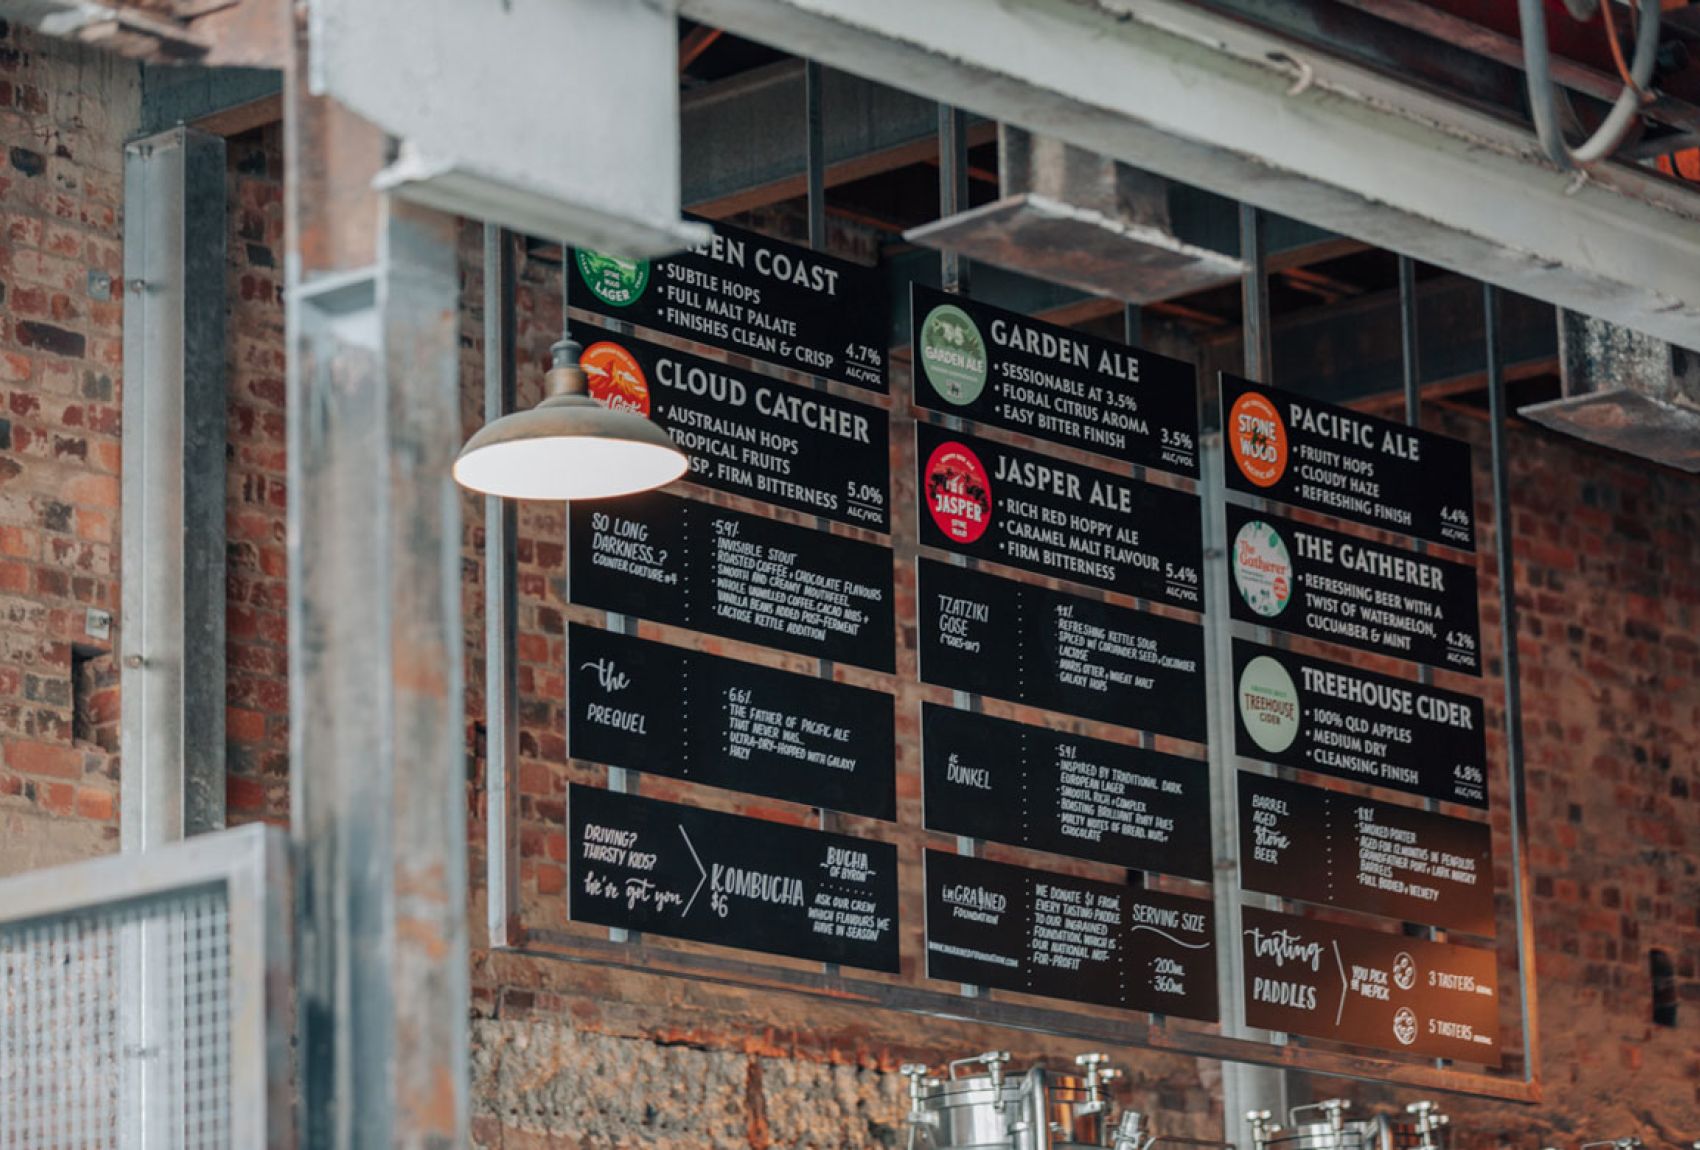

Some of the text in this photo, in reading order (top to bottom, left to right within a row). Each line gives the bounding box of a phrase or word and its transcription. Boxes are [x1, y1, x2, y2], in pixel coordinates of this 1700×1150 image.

[667, 263, 717, 292] SUBTLE
[723, 278, 760, 304] HOPS
[755, 249, 838, 295] COAST
[595, 282, 630, 301] LAGER
[668, 286, 796, 337] FULL MALT PALATE
[667, 308, 833, 369] FINISHES CLEAN & CRISP
[992, 320, 1139, 382] GARDEN ALE
[846, 343, 881, 366] 4.7%
[925, 346, 966, 369] GARDEN
[966, 359, 983, 374] ALE
[846, 366, 881, 384] ALC/VOL
[1002, 362, 1084, 397] SESSIONABLE
[1088, 387, 1102, 402] AT
[1107, 391, 1136, 411] 3.5%
[656, 359, 746, 406] CLOUD
[756, 388, 870, 443] CATCHER
[1003, 384, 1149, 435] FLORAL CITRUS AROMA
[668, 405, 798, 455] AUSTRALIAN HOPS
[1004, 404, 1125, 449] EASY BITTER FINISH
[1161, 428, 1193, 449] 3.5%
[1238, 414, 1276, 441] STONE
[1290, 404, 1374, 448] PACIFIC
[1382, 431, 1419, 461] ALE
[667, 426, 790, 474] TROPICAL FRUITS
[1162, 452, 1194, 467] ALC/VOL
[1301, 445, 1374, 477] FRUITY HOPS
[688, 455, 837, 510] ISP, FIRM BITTERNESS
[848, 481, 883, 504] 5.0%
[995, 456, 1081, 501] JASPER
[1089, 482, 1131, 513] ALE
[1302, 465, 1347, 488] CLOUDY
[1350, 478, 1379, 498] HAZE
[847, 506, 883, 523] ALC/VOL
[936, 494, 982, 522] JASPER
[1303, 485, 1411, 526] REFRESHING FINISH
[1440, 506, 1469, 525] 4.4%
[592, 513, 648, 542] SO LONG
[1007, 499, 1138, 545] RICH RED HOPPY ALE
[1441, 527, 1469, 542] ALC/VOL
[717, 537, 797, 565] INVISIBLE STOUT
[1007, 520, 1160, 571] CARAMEL MALT FLAVOUR
[1240, 540, 1255, 555] The
[593, 554, 665, 582] COUNTER CULTURE
[717, 550, 841, 591] ROASTED COFFEE CHOCOLATE
[1008, 541, 1115, 581] FIRM BITTERNESS
[1166, 563, 1197, 584] 5.4%
[1239, 552, 1287, 576] Gatherer
[1294, 532, 1444, 591] THE GATHERER
[769, 576, 801, 594] CREAMY
[1166, 586, 1197, 601] ALC/VOL
[1306, 573, 1373, 602] REFRESHING
[1375, 590, 1401, 609] BEER
[1404, 597, 1432, 616] WITH
[1434, 605, 1443, 619] A
[939, 594, 988, 622] TZATZIKI
[1306, 593, 1437, 638] TWIST OF WATERMELON,
[717, 605, 826, 641] LACTOSE KETTLE ADDITION
[939, 614, 968, 637] GOSE
[1058, 618, 1157, 651] REFRESHING KETTLE SOUR
[1307, 613, 1411, 650] CUCUMBER & MINT
[1446, 631, 1474, 649] 4.2%
[1447, 652, 1475, 666] ALC/VOL
[581, 659, 630, 691] the
[1060, 672, 1107, 692] GALAXY HOPS
[1244, 693, 1294, 721] TREEHOUSE
[1302, 667, 1472, 730] TREEHOUSE CIDER
[588, 703, 646, 735] PREQUEL
[729, 703, 850, 742] THE FATHER OF PACIFIC ALE
[730, 717, 779, 739] THAT NEVER
[1259, 713, 1281, 725] CIDER
[1314, 709, 1411, 743] 100% QLD APPLES
[1313, 729, 1387, 757] MEDIUM DRY
[826, 754, 856, 772] GALAXY
[948, 763, 991, 789] DUNKEL
[1060, 760, 1110, 779] INSPIRED BY
[1314, 749, 1418, 784] CLEANSING FINISH
[1454, 764, 1482, 783] 4.8%
[1060, 772, 1125, 794] EUROPEAN LAGER
[1455, 786, 1483, 800] ALC/VOL
[1253, 794, 1289, 816] BARREL
[1253, 811, 1276, 827] AGED
[584, 824, 637, 848] DRIVING?
[583, 842, 656, 871] THIRSTY KIDS?
[826, 846, 868, 870] BUCHA
[1254, 846, 1278, 864] BEER
[626, 878, 684, 913] got you
[711, 863, 804, 906] KOMBUCHA
[711, 891, 728, 918] $6
[1132, 903, 1205, 933] SERVING SIZE
[1243, 928, 1324, 972] tasting
[1254, 977, 1316, 1010] PADDLES
[1438, 973, 1475, 991] TASTERS
[1437, 1020, 1472, 1040] TASTERS
